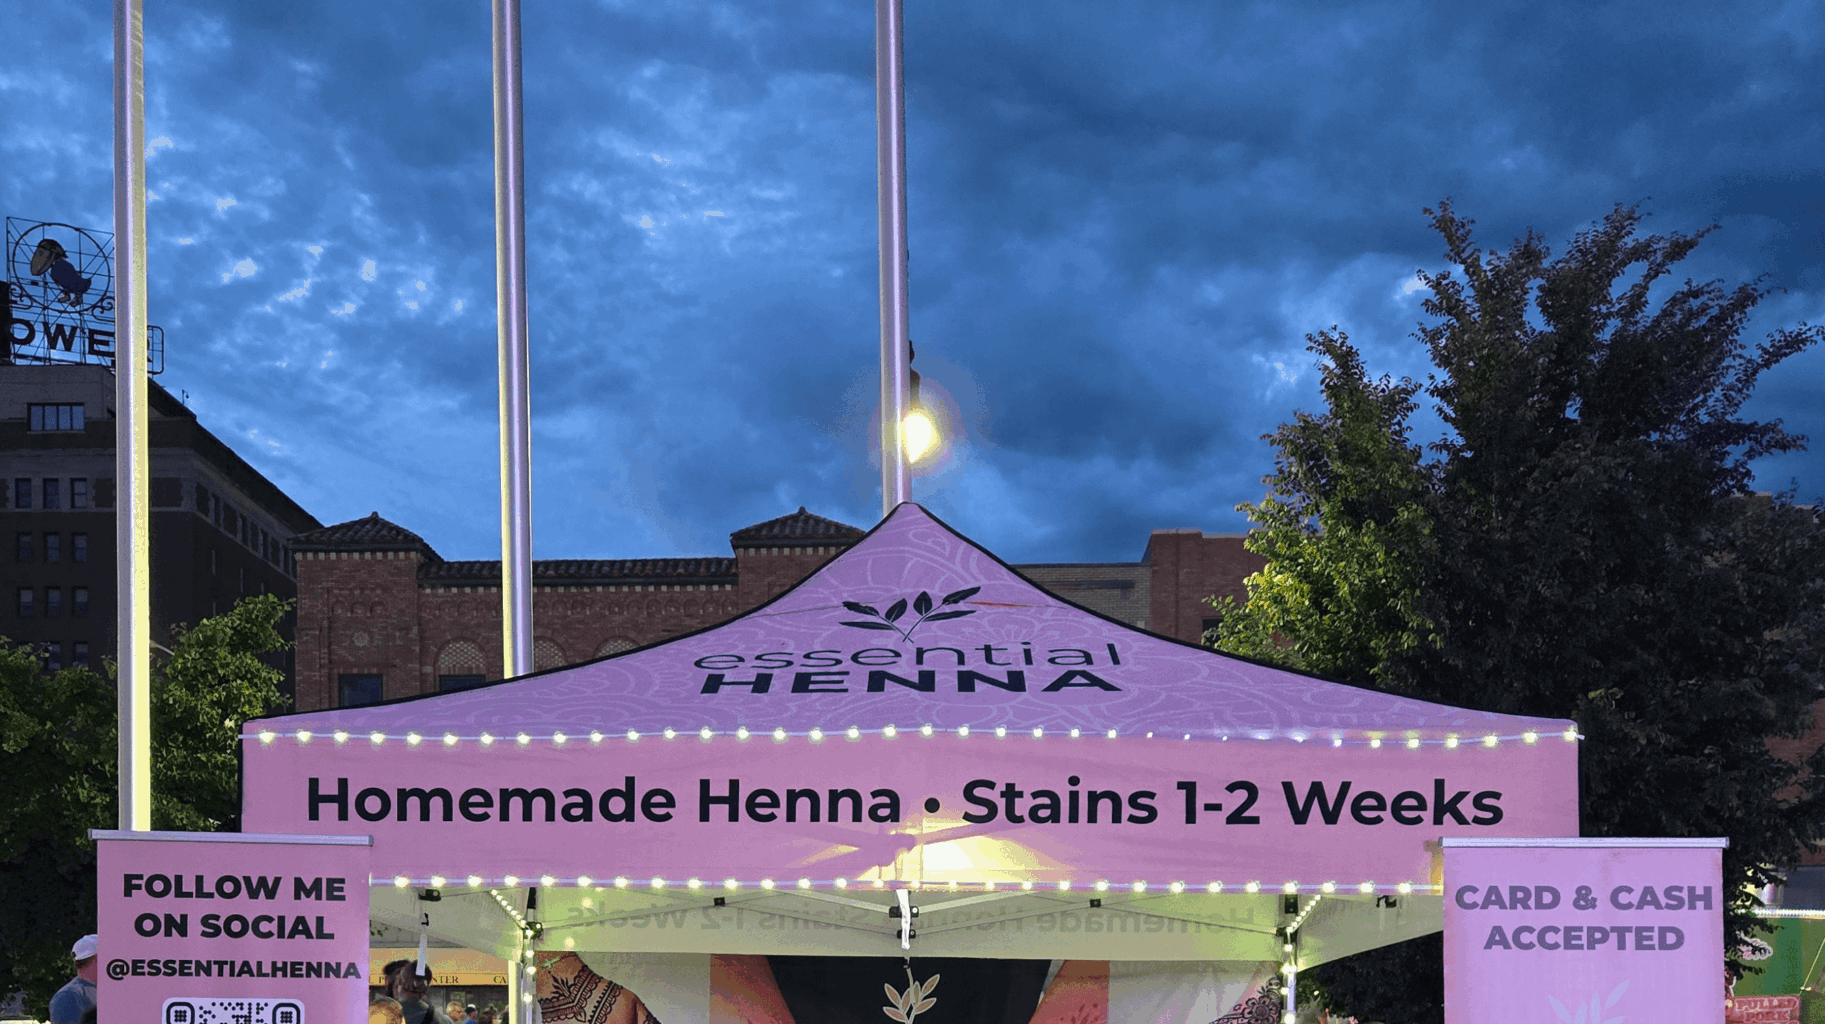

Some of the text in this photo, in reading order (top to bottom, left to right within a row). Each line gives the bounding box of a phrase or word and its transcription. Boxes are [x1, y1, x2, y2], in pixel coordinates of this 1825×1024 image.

[6, 318, 152, 362] OWE
[694, 641, 1122, 669] essential
[701, 669, 1123, 694] HENNA
[308, 775, 1504, 826] Homemade Henna Stains 1-2 Weeks
[123, 873, 346, 902] FOLLOW ME
[1454, 884, 1713, 911] CARD & CASH
[134, 912, 335, 940] ON SOCIAL
[1483, 925, 1686, 951] ACCEPTED
[106, 958, 362, 981] @ESSENTIALHENNA
[1743, 1011, 1790, 1022] PORK
